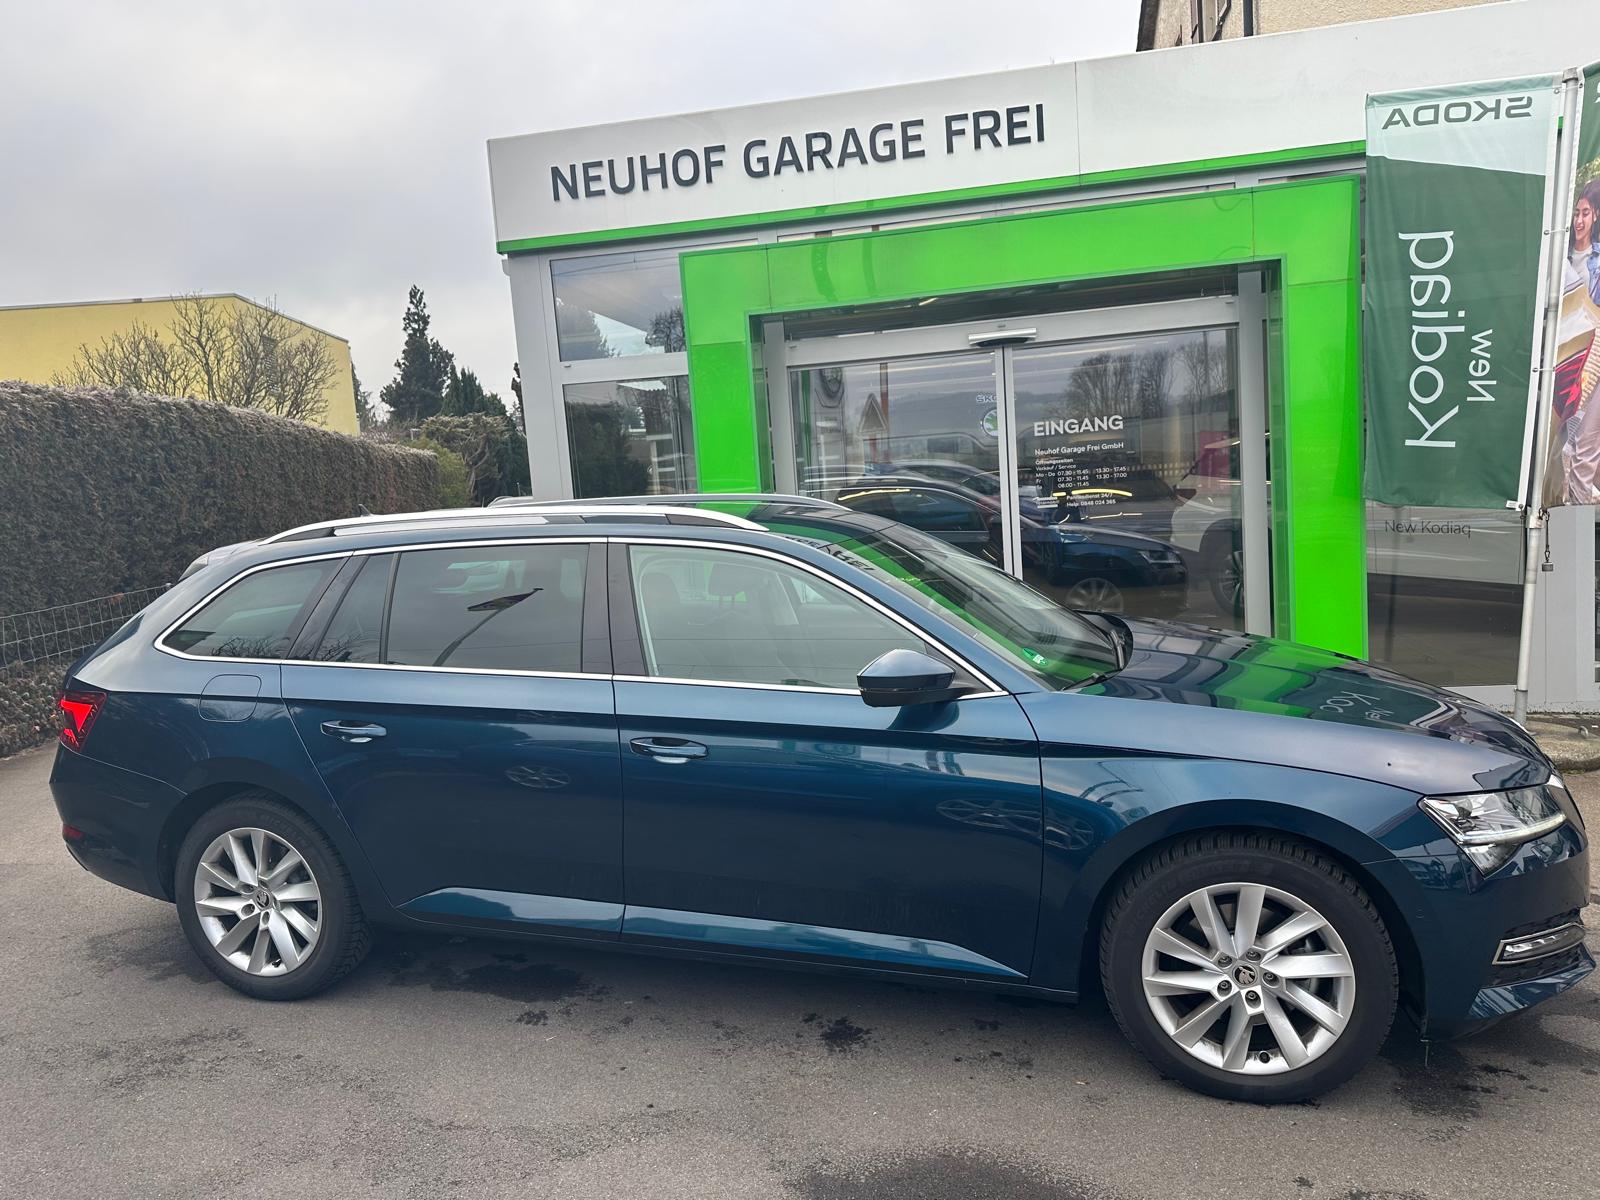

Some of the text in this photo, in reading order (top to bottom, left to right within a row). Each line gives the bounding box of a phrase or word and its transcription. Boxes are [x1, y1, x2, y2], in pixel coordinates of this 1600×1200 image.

[550, 103, 1046, 202] NEUHOF GARAGE FREI
[1033, 414, 1124, 437] EINGANG
[1034, 442, 1124, 456] Neuhof Garage Frei GmbH
[1385, 519, 1471, 538] New Kodiaq
